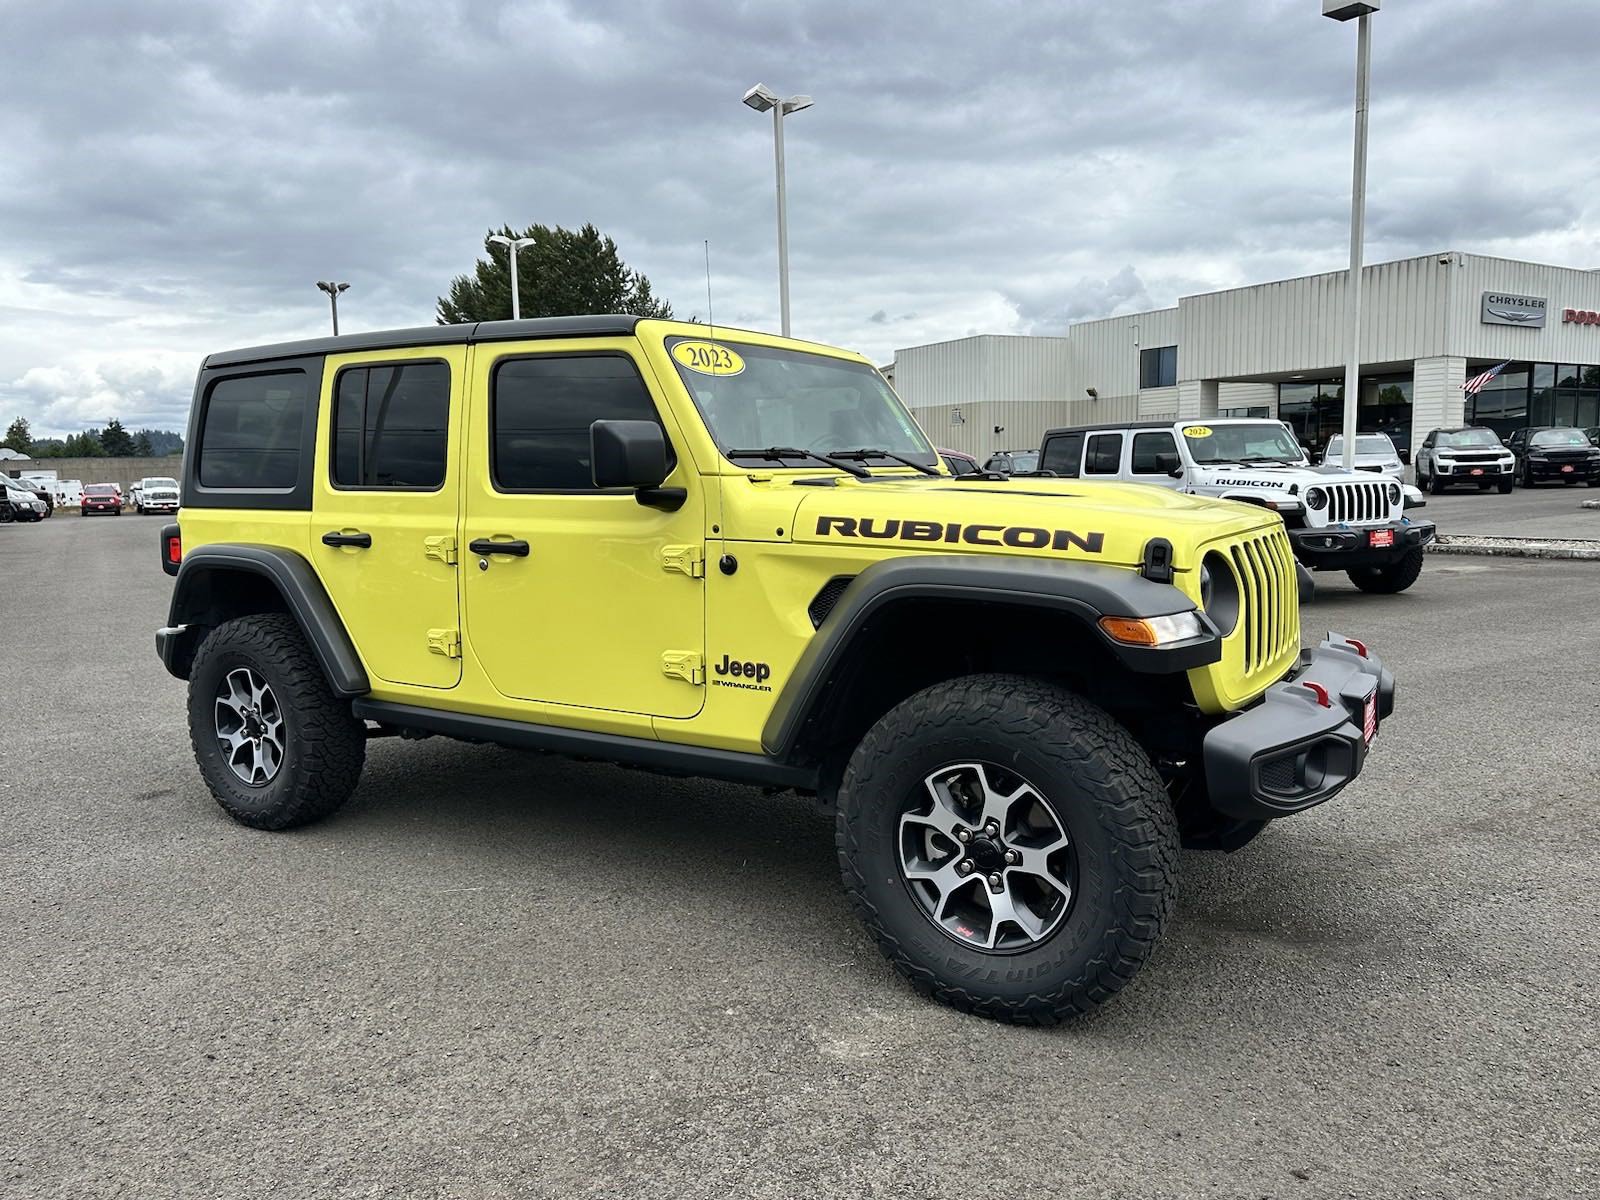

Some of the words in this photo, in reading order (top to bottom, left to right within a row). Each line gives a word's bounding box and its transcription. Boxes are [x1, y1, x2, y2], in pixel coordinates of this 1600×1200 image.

[1488, 295, 1545, 308] CHRYSLER
[686, 347, 732, 368] 2023
[1188, 428, 1207, 436] 2022
[1215, 479, 1284, 488] RUBICON
[815, 516, 1105, 553] RUBICON
[714, 654, 770, 683] Jeep
[720, 680, 772, 692] WRANGLER
